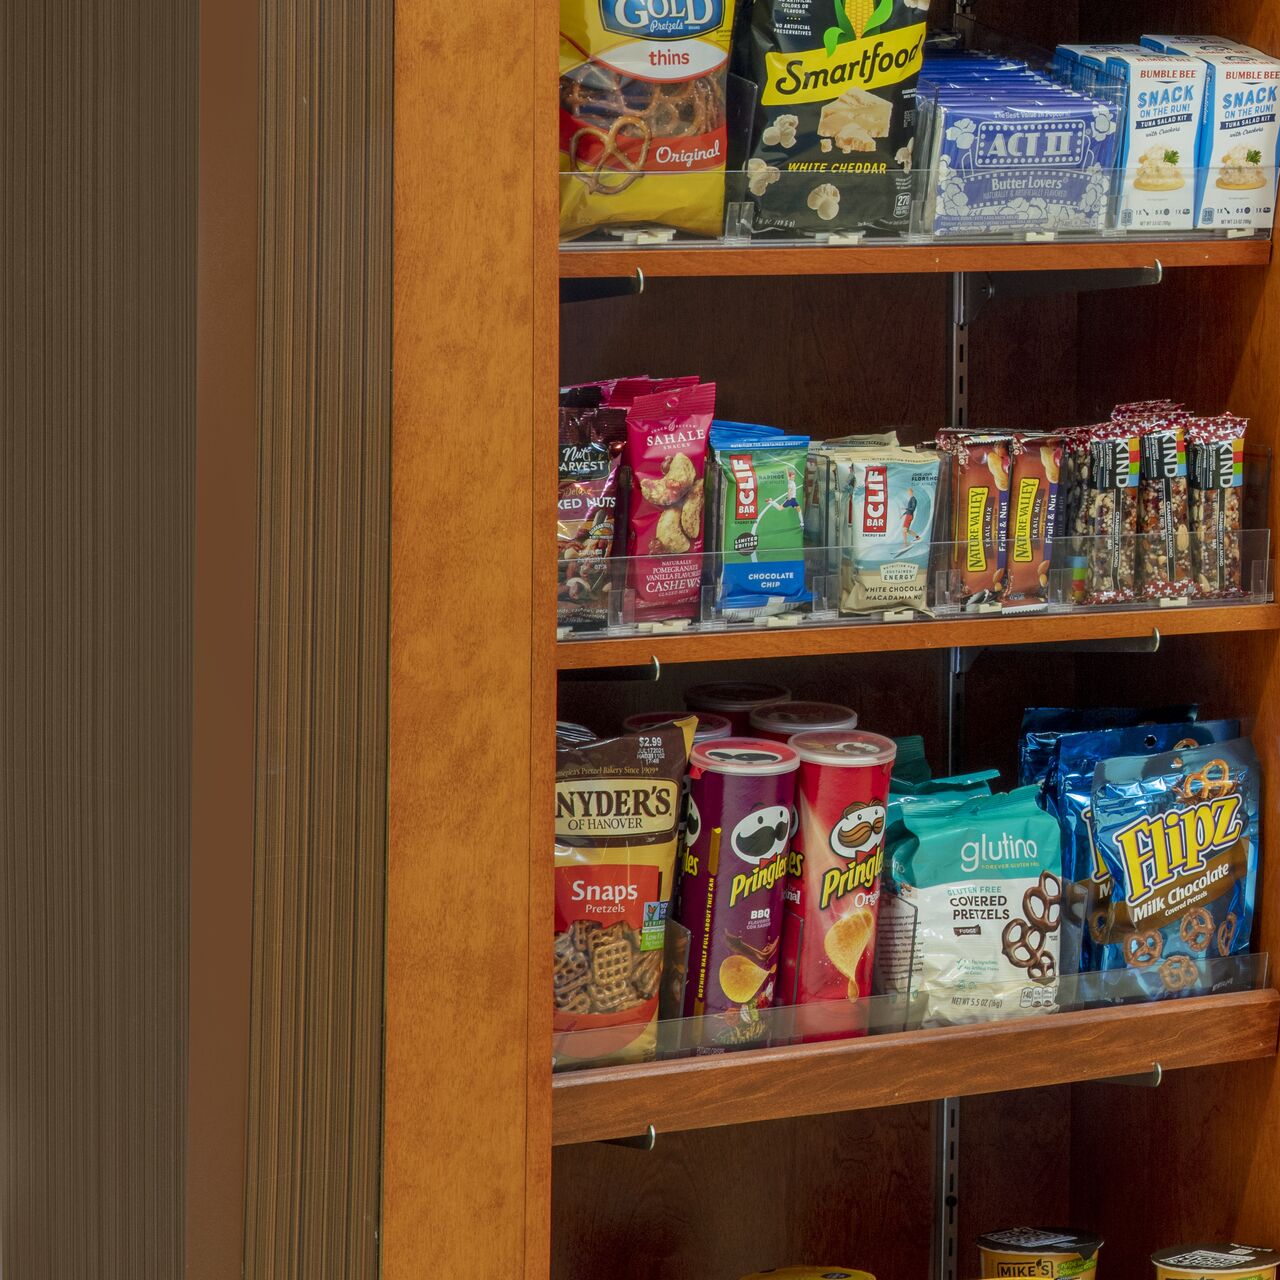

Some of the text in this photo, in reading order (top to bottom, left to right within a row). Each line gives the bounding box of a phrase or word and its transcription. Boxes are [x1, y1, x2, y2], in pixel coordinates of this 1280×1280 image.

[650, 19, 684, 32] Pretzels
[649, 50, 689, 66] thins
[775, 34, 921, 96] Smartfood
[1140, 70, 1196, 78] BUMBLE BEE
[1226, 71, 1280, 80] BUMBLE BEE
[1138, 85, 1194, 108] SNACK
[1222, 86, 1278, 110] SNACK
[1153, 107, 1168, 116] THE
[1170, 104, 1190, 114] RUN!
[987, 132, 1073, 156] ACT II
[656, 140, 720, 165] Original
[788, 163, 886, 174] WHITE CHEDDAR
[992, 177, 1062, 190] Butter Lovers
[647, 430, 705, 446] SAHALE
[1116, 439, 1130, 487] KIND
[733, 458, 755, 504] CLIF
[738, 505, 755, 514] BAR
[1000, 502, 1008, 519] Nut
[866, 519, 884, 527] BAR
[734, 536, 758, 545] LIMITED
[734, 541, 758, 550] EDITION
[748, 572, 794, 580] CHOCOLATE
[646, 578, 701, 593] CASHEWS
[639, 737, 662, 748] $2.99
[568, 818, 643, 831] OF HANOVER
[961, 833, 1038, 873] glutino
[1116, 794, 1241, 905] Flipz
[729, 854, 789, 907] Pringles
[572, 880, 638, 903] Snaps
[947, 887, 977, 896] GLUTEN
[1132, 862, 1230, 923] Milk Chocolate
[950, 896, 1008, 906] COVERED
[1164, 891, 1208, 917] Covered Pretzels
[586, 904, 626, 914] Pretzels
[750, 908, 771, 919] BBQ
[953, 909, 1010, 920] PRETZELS
[1000, 1259, 1050, 1278] MIKE'S
